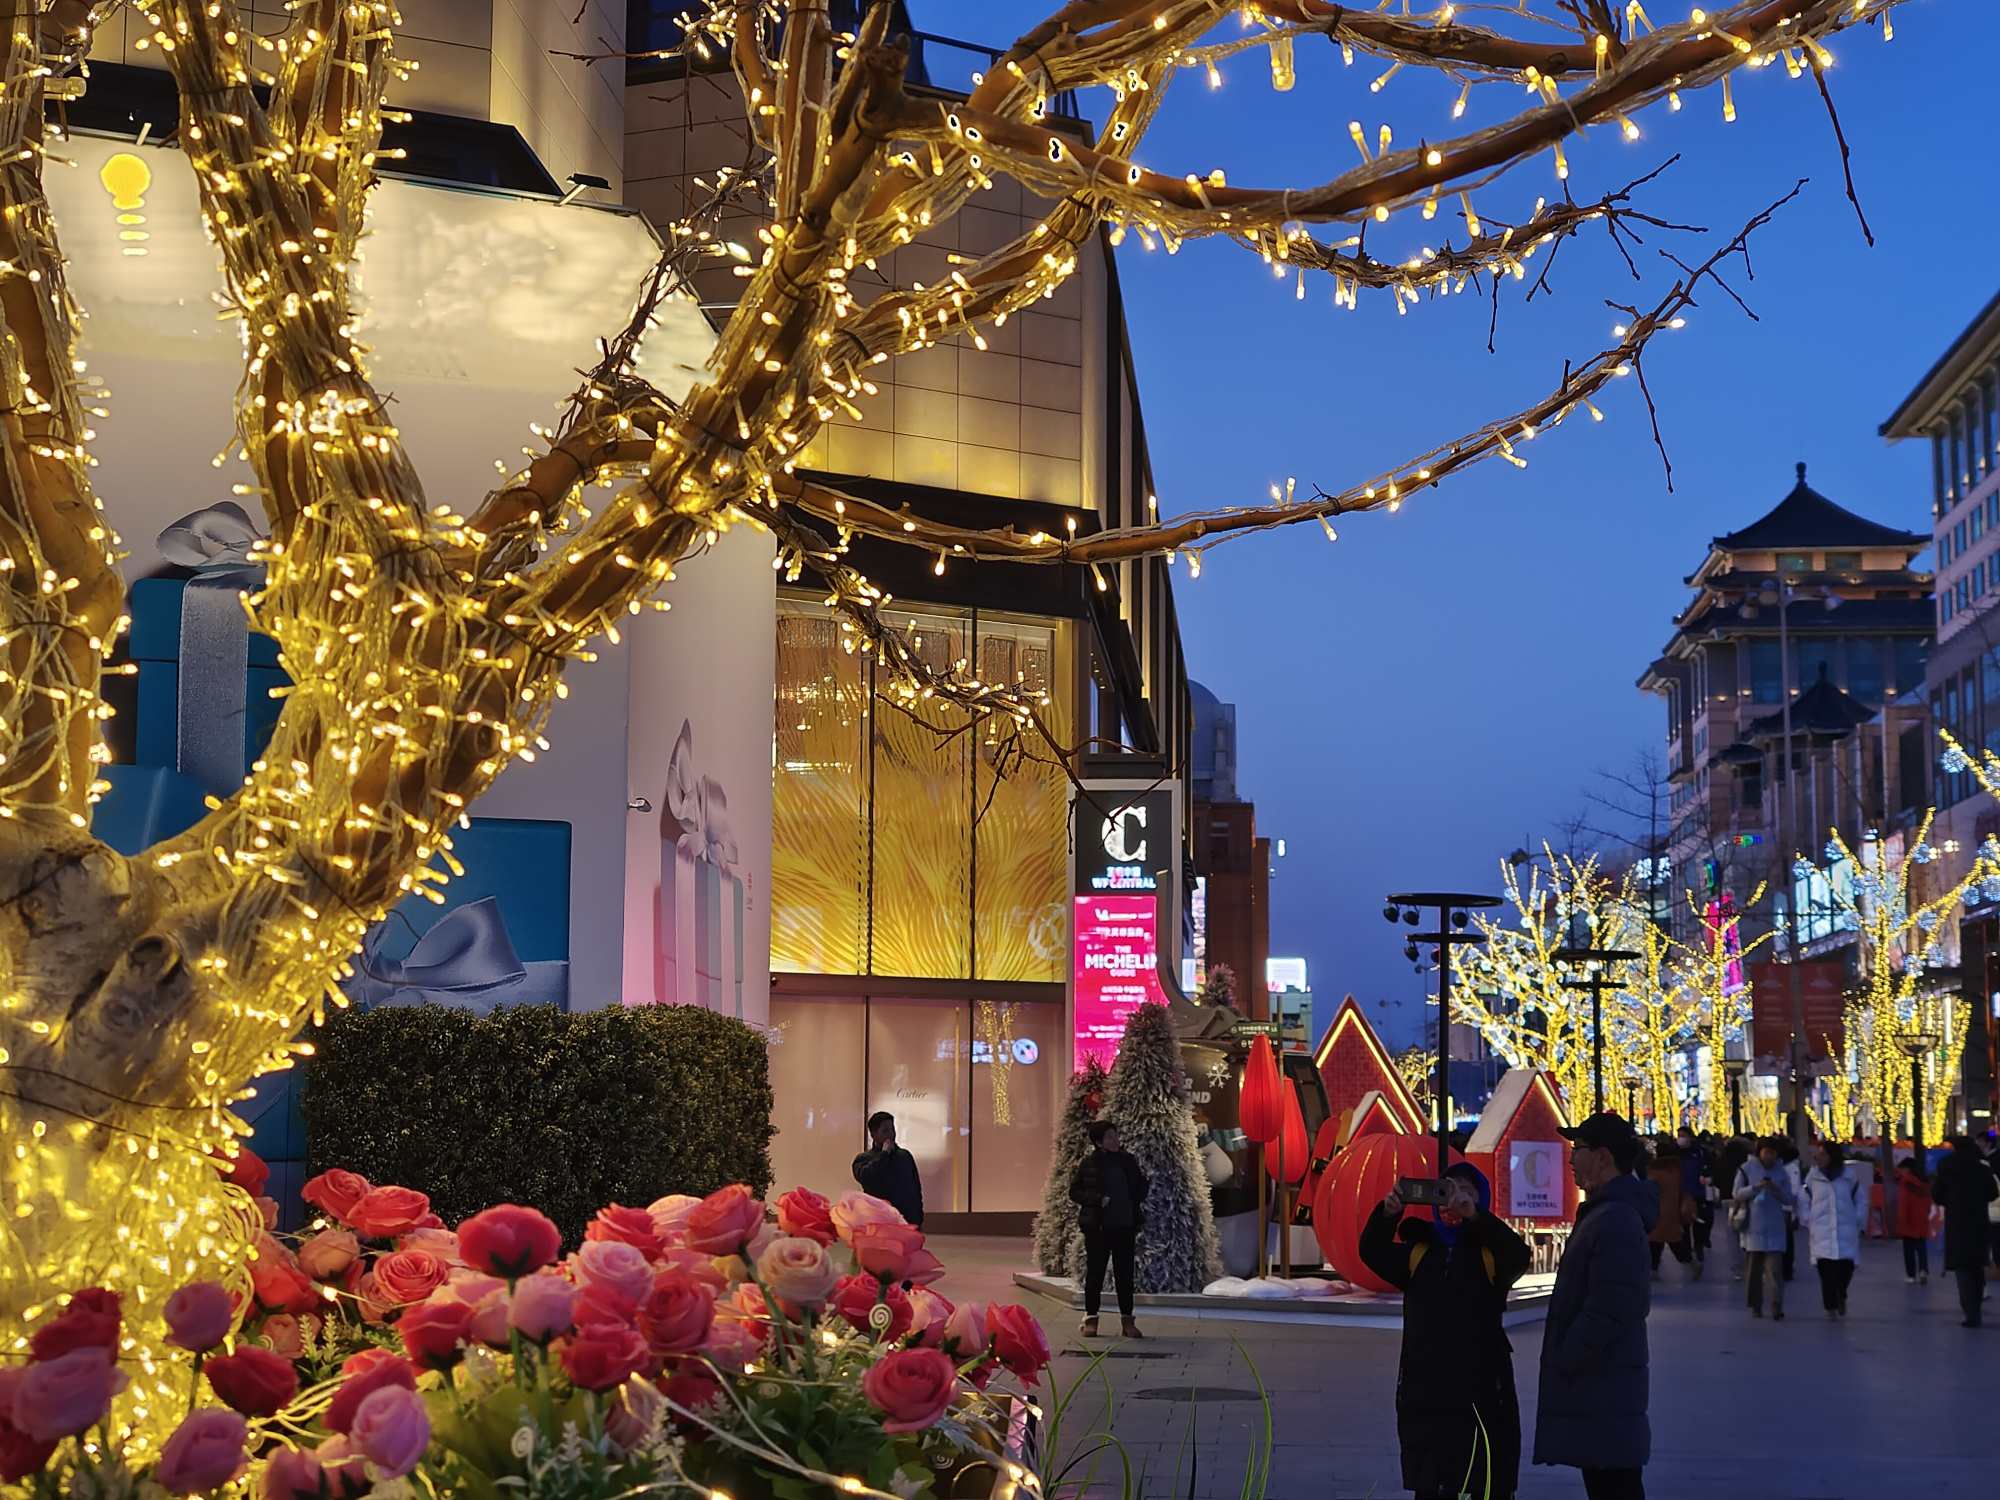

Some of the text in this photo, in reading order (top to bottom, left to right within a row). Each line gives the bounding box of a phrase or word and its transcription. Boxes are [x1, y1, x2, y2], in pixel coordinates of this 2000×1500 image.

[1102, 805, 1146, 862] C
[896, 1087, 928, 1099] Cartier
[1523, 1149, 1551, 1189] C
[1528, 1201, 1557, 1209] CENTRAL
